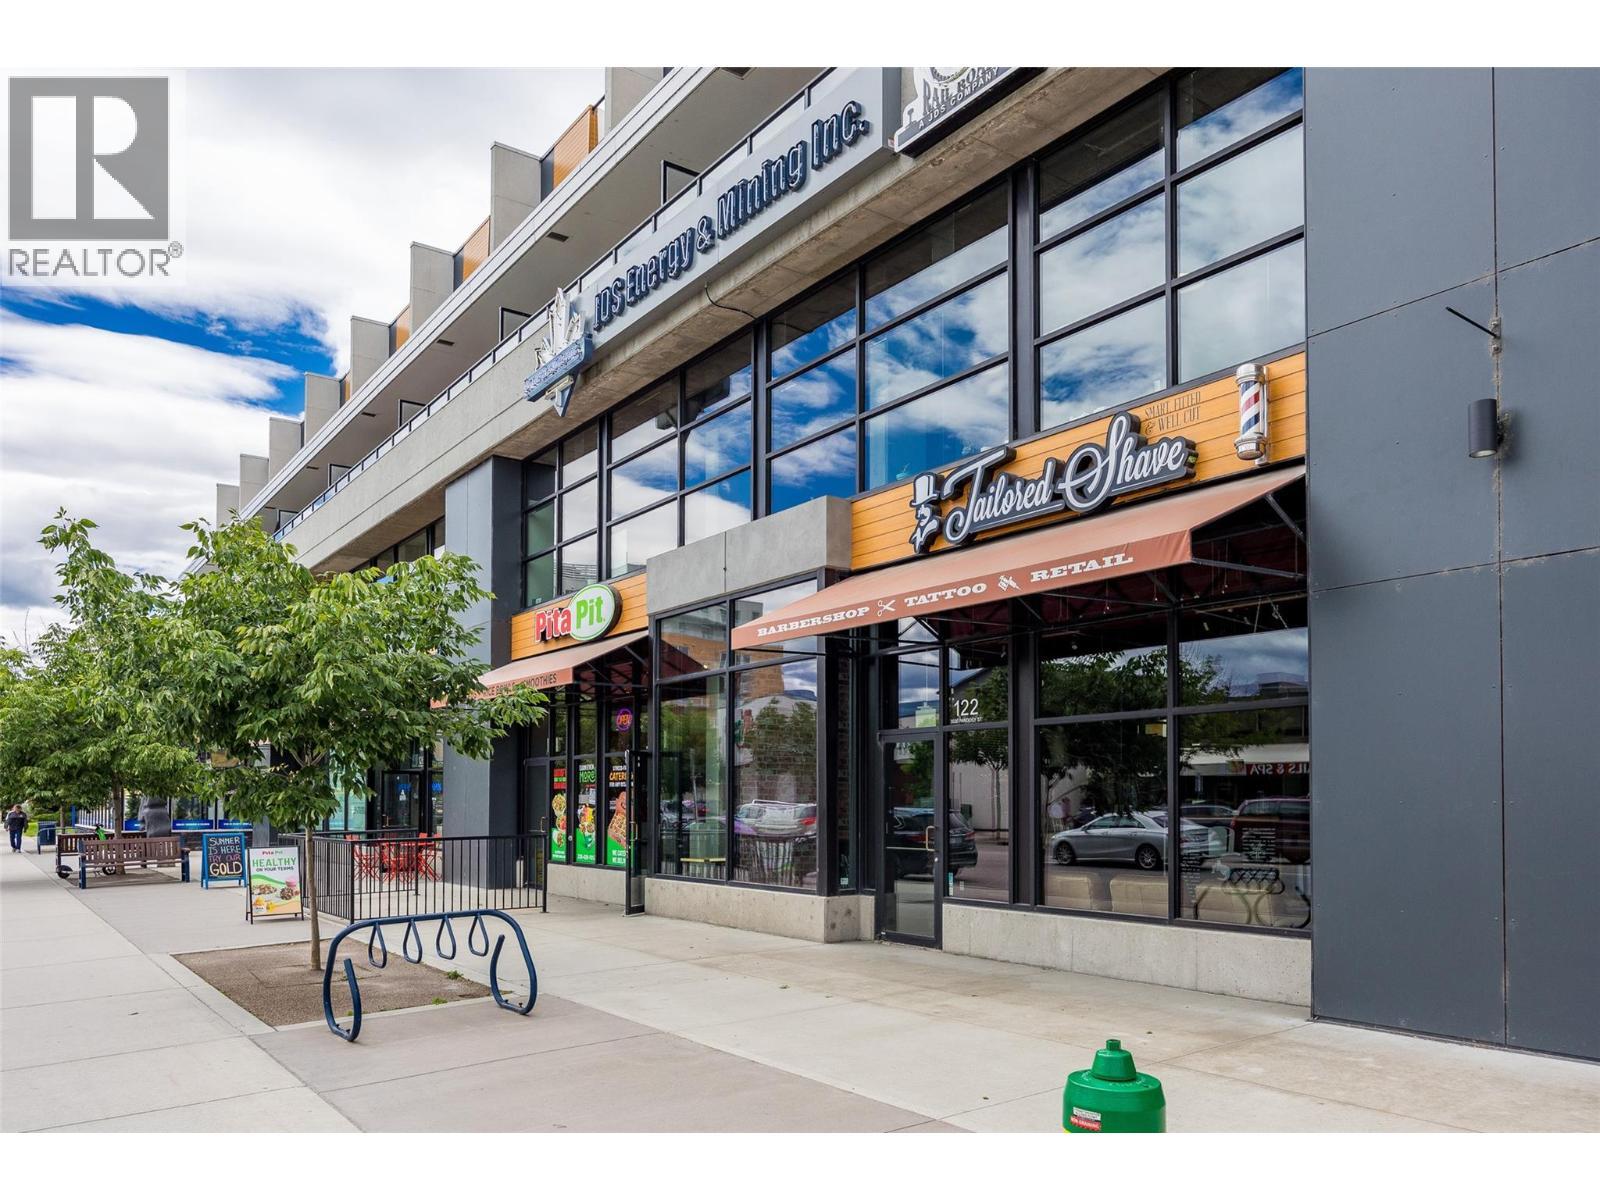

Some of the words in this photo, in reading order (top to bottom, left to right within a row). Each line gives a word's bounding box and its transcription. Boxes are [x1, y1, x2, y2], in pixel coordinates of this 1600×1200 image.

[918, 119, 925, 130] A
[928, 104, 946, 122] JDS
[950, 68, 998, 106] COMPANY
[625, 226, 694, 306] Energy
[696, 214, 714, 253] &
[717, 139, 806, 240] Mining
[811, 100, 870, 170] Inc.
[1158, 413, 1181, 432] WELL
[1183, 406, 1201, 424] CUT
[943, 444, 1060, 546] Tailored
[1058, 410, 1195, 513] Shave
[757, 605, 870, 637] BARBERSHOP
[904, 582, 988, 607] TATTOO
[1030, 552, 1133, 583] RETAIL
[534, 606, 572, 643] Pita
[575, 595, 604, 630] Pit
[953, 698, 979, 717] 122
[208, 846, 218, 856] IS
[220, 845, 241, 855] HERE
[209, 836, 240, 846] SUMMER
[209, 861, 243, 876] GOLD
[252, 857, 296, 868] HEALTHY
